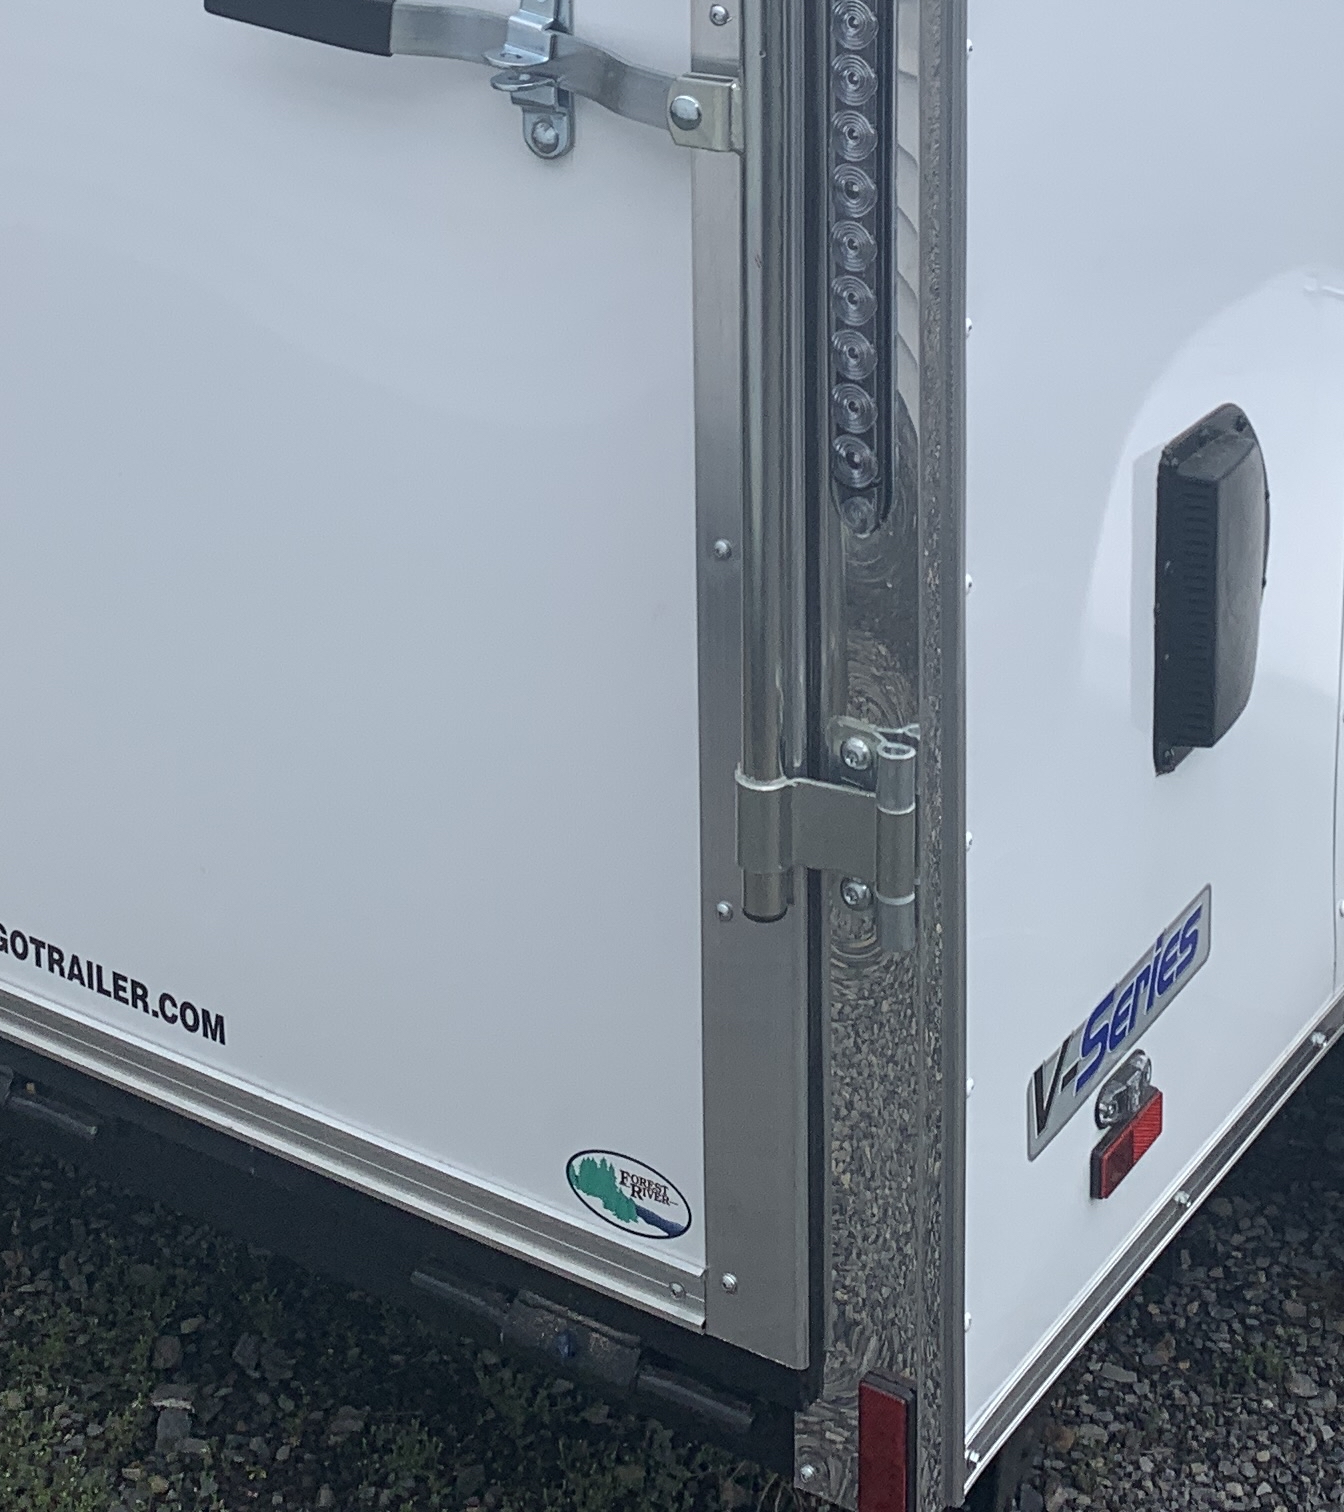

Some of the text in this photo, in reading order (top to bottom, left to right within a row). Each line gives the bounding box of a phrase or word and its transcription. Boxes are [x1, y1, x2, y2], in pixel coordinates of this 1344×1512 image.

[1032, 902, 1204, 1138] V-Series
[619, 1169, 670, 1196] FOREST
[630, 1184, 671, 1206] RIVER
